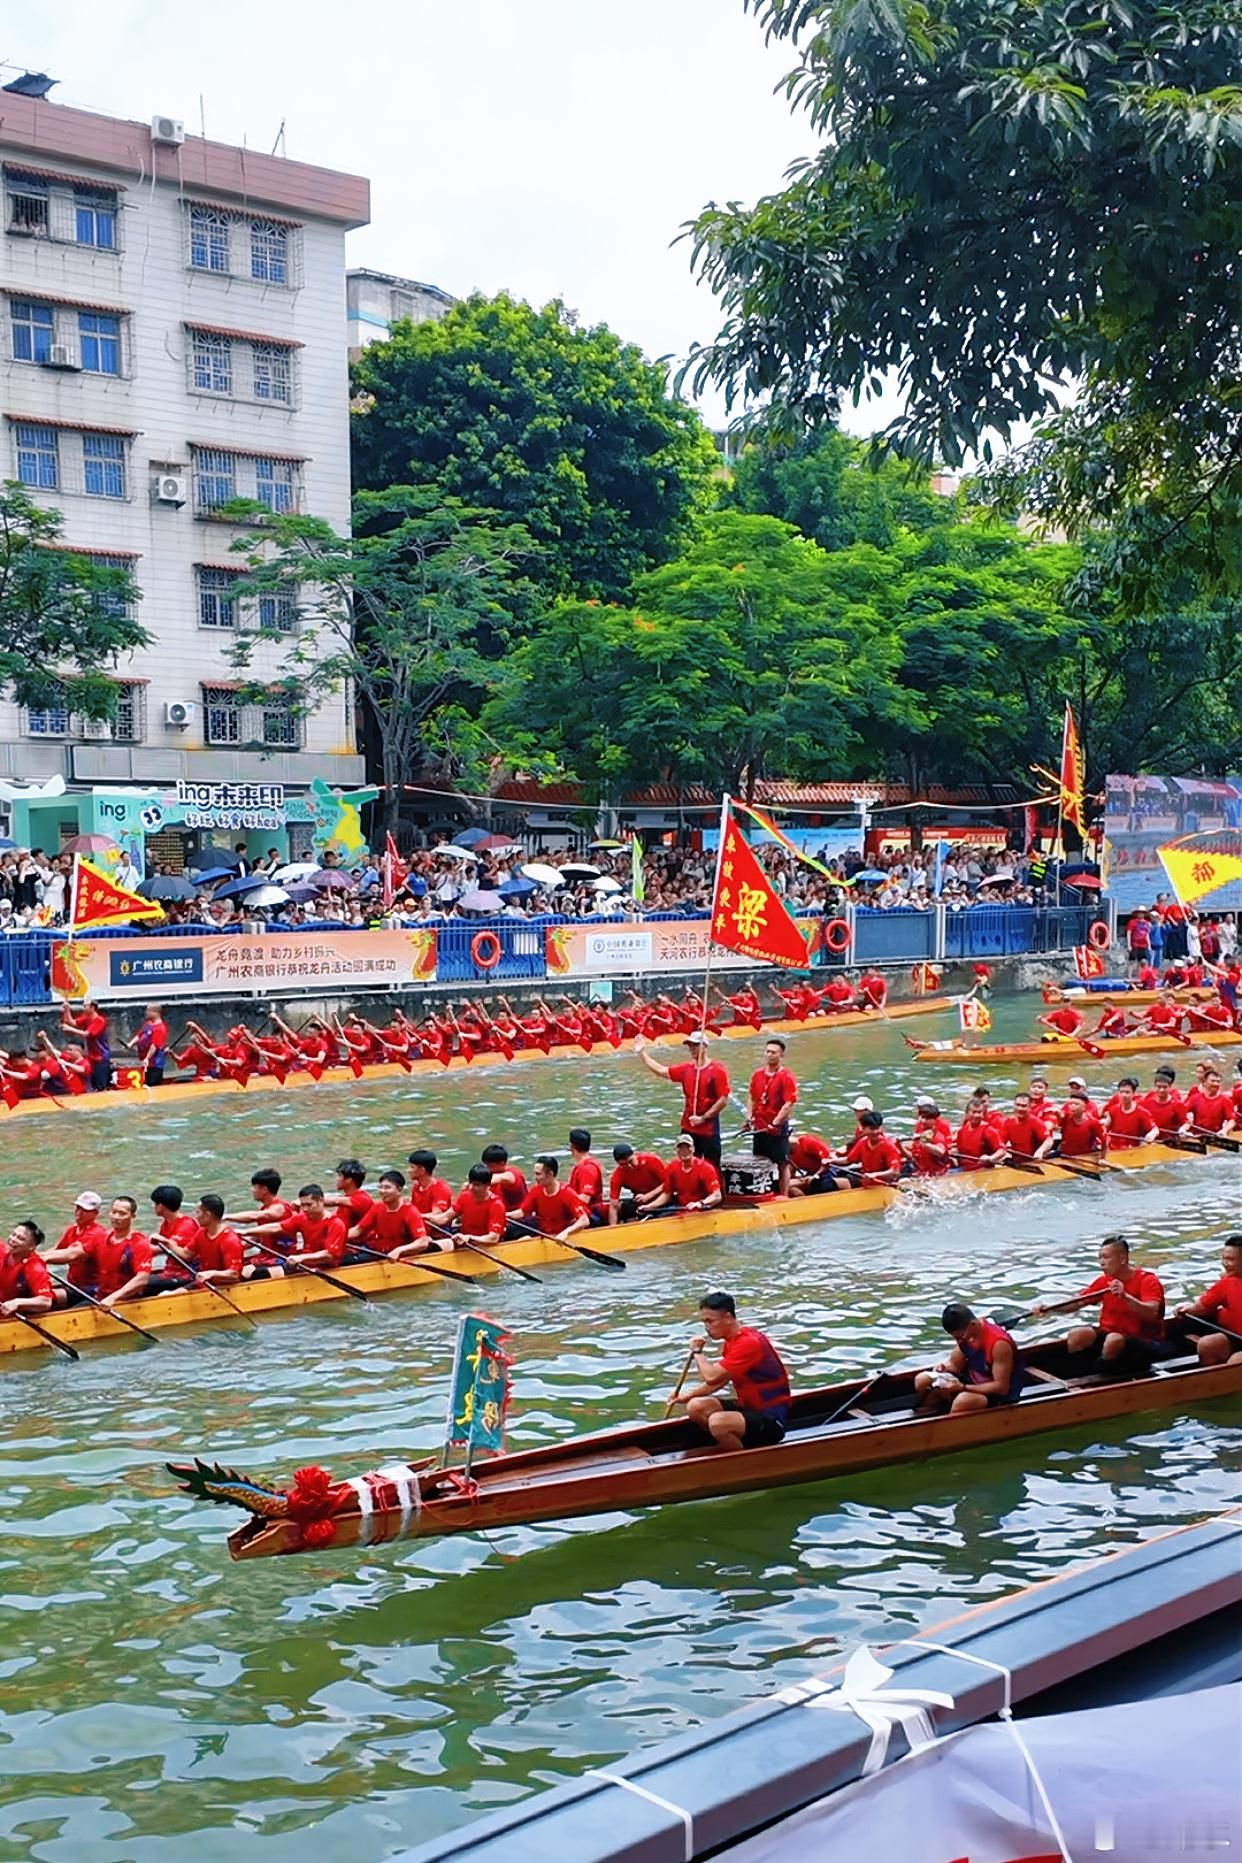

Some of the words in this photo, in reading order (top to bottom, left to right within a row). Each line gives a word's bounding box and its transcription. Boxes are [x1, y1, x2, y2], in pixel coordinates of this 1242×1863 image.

[100, 801, 126, 821] ing
[732, 881, 768, 940] 梁
[270, 945, 336, 960] 助力乡村振兴
[132, 958, 194, 972] 广州农商银行
[215, 959, 396, 978] 广州农商银行恭祝龙舟活动圆满成功
